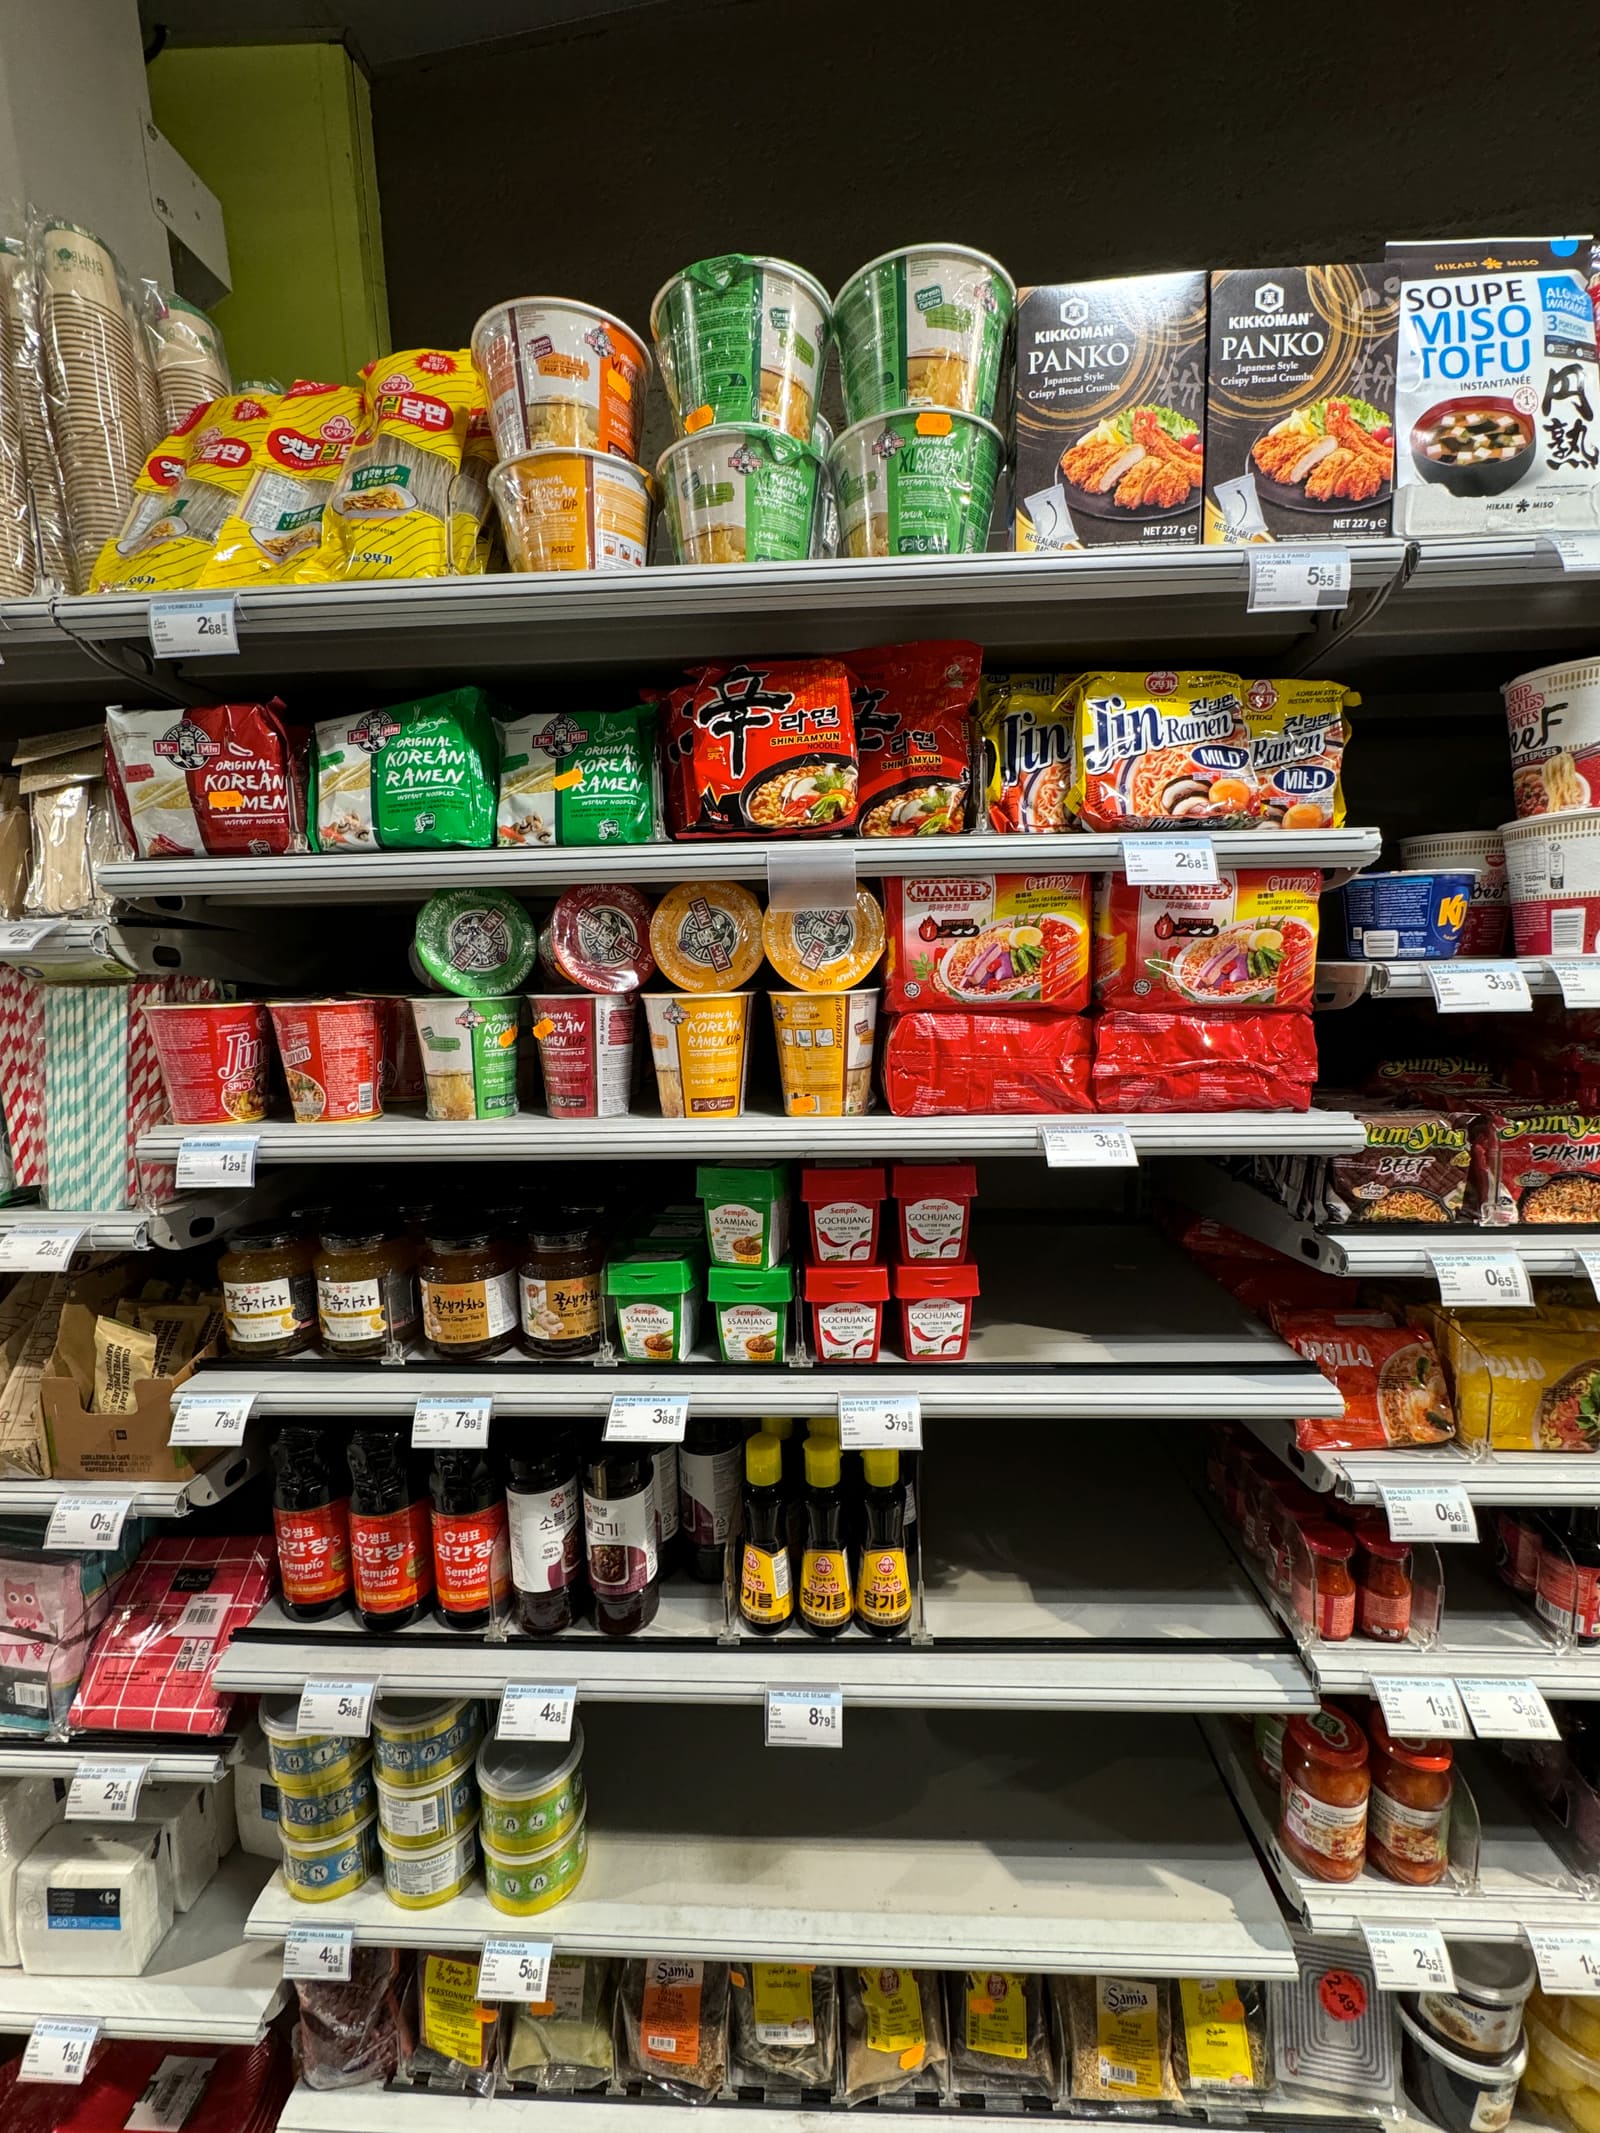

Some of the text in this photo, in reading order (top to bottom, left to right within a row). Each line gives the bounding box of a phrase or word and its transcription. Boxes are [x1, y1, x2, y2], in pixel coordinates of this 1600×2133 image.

[1434, 259, 1539, 271] HIKARI MISO
[1406, 280, 1525, 312] SOUPE
[1229, 313, 1309, 329] KIKKOMAN
[1410, 304, 1531, 344] MISO
[1547, 315, 1557, 331] 3
[1035, 324, 1115, 344] KIKKOMAN
[1221, 332, 1324, 361] PANKO
[1028, 343, 1129, 375] PANKO
[1411, 339, 1531, 379] TOFU
[1236, 360, 1299, 374] Japanese Style
[1044, 372, 1105, 388] Japanese Style
[1221, 371, 1314, 387] Crispy Bread Crumbs
[1460, 376, 1531, 391] INSTANTANÉE
[1029, 382, 1120, 400] Crispy Bread Crumbs
[402, 397, 447, 426] 당면
[278, 435, 322, 460] 옛날
[917, 447, 964, 462] KOREAN
[900, 448, 915, 473] XL
[1486, 500, 1554, 511] HIKARI MISO
[1333, 518, 1368, 528] NET 227
[1144, 525, 1177, 537] NET 227
[1214, 522, 1253, 540] RESEALABLE
[1024, 532, 1064, 551] RESEALABLE
[362, 552, 393, 564] 오뚜기
[1189, 694, 1239, 718] 진라면
[698, 664, 795, 780] 辛
[780, 706, 840, 734] 라면
[396, 736, 452, 748] ORIGINAL
[771, 732, 840, 746] SHIN RAMYUN
[890, 729, 938, 755] 라면
[1086, 695, 1234, 774] Jin Ramen
[585, 744, 636, 756] ORIGINAL
[808, 741, 840, 750] NOODLE
[1003, 712, 1070, 785] Jin
[1253, 733, 1325, 768] Ramen
[215, 759, 275, 771] ORIGINAL
[386, 748, 465, 767] KOREAN
[881, 755, 942, 770] SHIN RAMYUN
[1200, 748, 1242, 767] MILD
[573, 758, 643, 776] KOREAN
[911, 765, 942, 774] NOODLE
[204, 773, 286, 792] KOREAN
[386, 769, 464, 787] RAMEN
[571, 775, 642, 793] RAMEN
[1283, 769, 1326, 789] MILD
[916, 885, 982, 897] MAMEE
[1025, 876, 1073, 891] Curry
[1156, 885, 1224, 895] MAMEE
[1267, 876, 1316, 892] Curry
[688, 1020, 741, 1033] KOREAN
[688, 1034, 742, 1046] RAMEN CUP
[218, 1032, 268, 1080] Jin
[228, 1081, 252, 1091] SPICY
[1500, 1115, 1569, 1140] Yum
[1377, 1157, 1435, 1175] BEEF
[723, 1208, 748, 1217] Sempio
[830, 1207, 857, 1215] Sempio
[921, 1203, 949, 1212] Sempio
[715, 1217, 758, 1228] SSAMJANG
[818, 1216, 871, 1226] GOCHUJANG
[908, 1212, 962, 1222] GOCHUJANG
[633, 1307, 659, 1316] Sempio
[735, 1308, 762, 1316] Sempio
[834, 1305, 861, 1314] Sempio
[924, 1302, 951, 1310] Sempio
[626, 1315, 669, 1326] SSAMJANG
[727, 1317, 772, 1327] SSAMJANG
[821, 1315, 874, 1325] GOCHUJANG
[911, 1311, 963, 1320] GOCHUJANG
[292, 1526, 315, 1538] 샘표
[367, 1532, 391, 1544] 샘표
[457, 1529, 480, 1542] 샘표
[284, 1559, 324, 1572] Sempio
[360, 1565, 399, 1578] Sempio
[445, 1562, 488, 1577] Sempio
[287, 1571, 323, 1581] Soy Sauce
[362, 1578, 398, 1588] Soy Sauce
[448, 1576, 487, 1587] Soy Sauce
[809, 1579, 839, 1593] 고소한
[872, 1579, 902, 1593] 고소한
[803, 1588, 846, 1610] 참기름
[864, 1589, 907, 1610] 참기름
[657, 1963, 694, 1979] Samia
[1107, 1987, 1148, 2008] Samia
